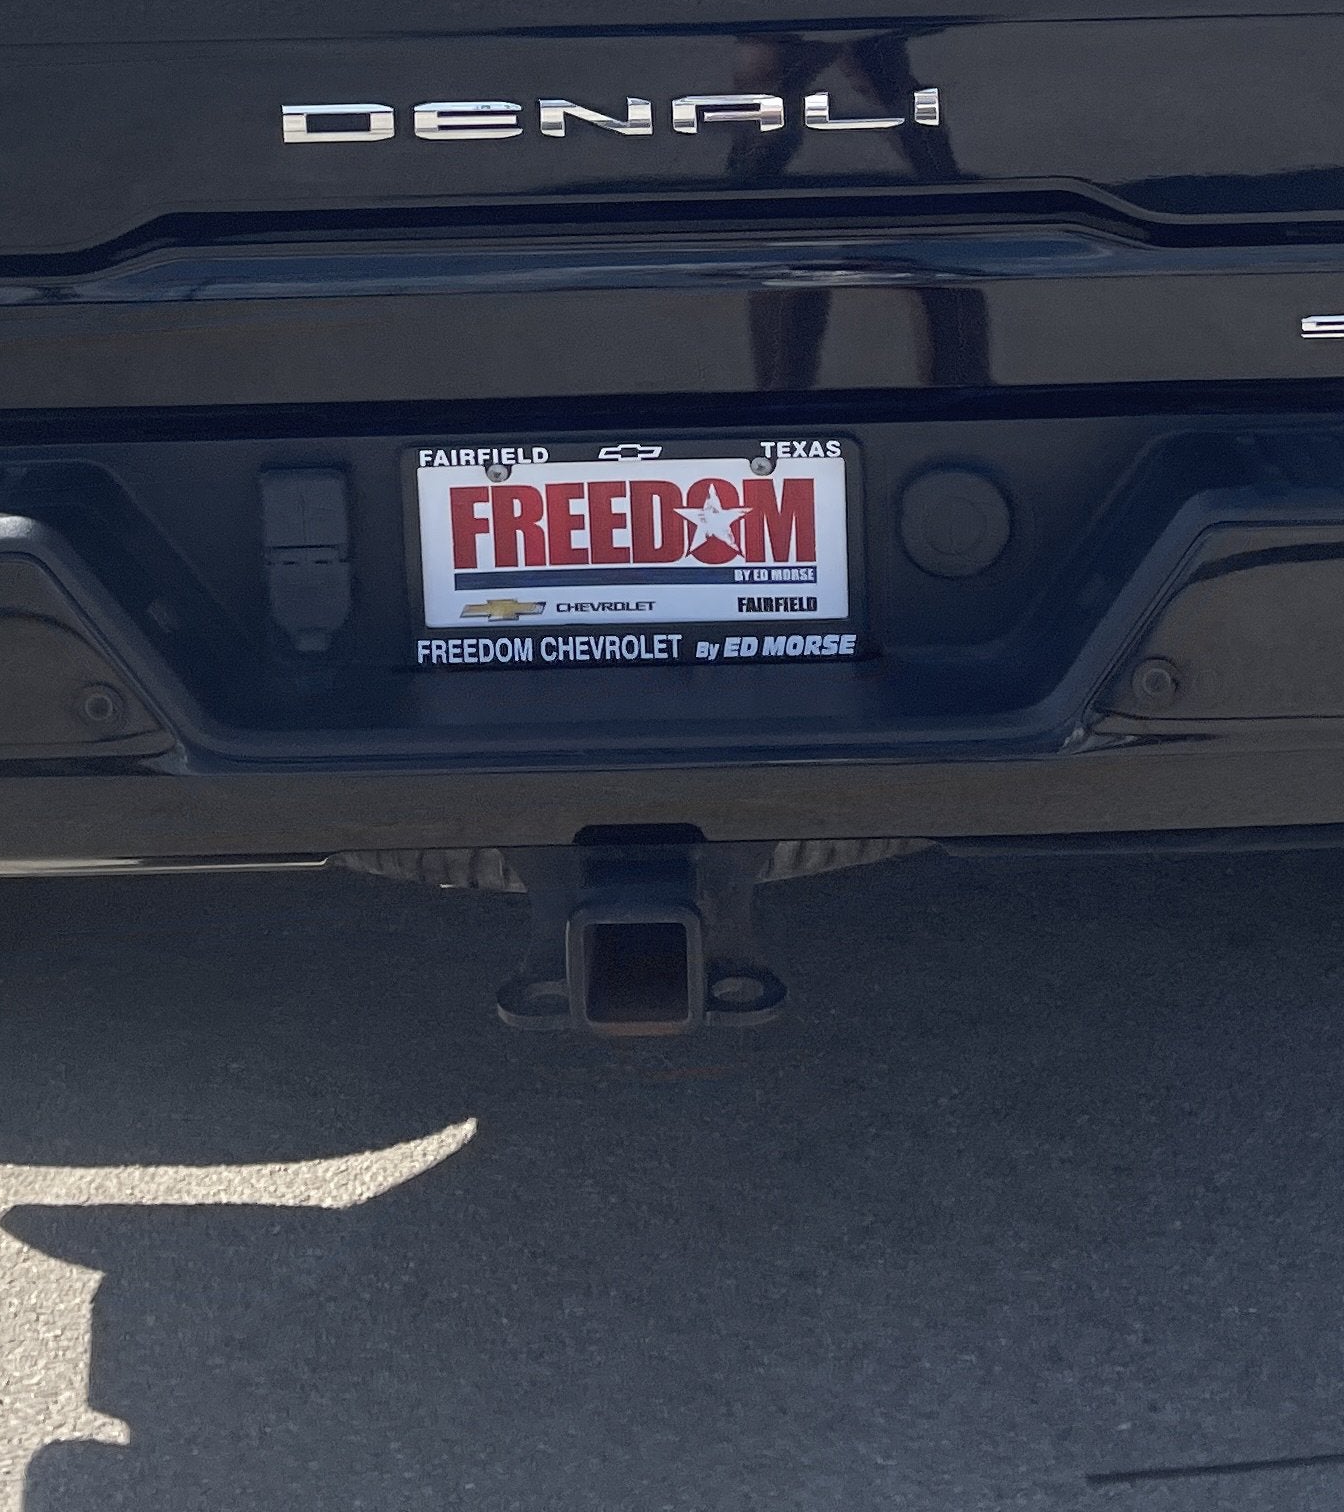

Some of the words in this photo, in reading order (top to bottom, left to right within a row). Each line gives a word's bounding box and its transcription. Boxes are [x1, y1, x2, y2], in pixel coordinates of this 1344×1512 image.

[280, 87, 940, 144] DENALI
[418, 447, 549, 468] FAIRFIELD
[760, 441, 843, 460] TEXAS
[449, 477, 817, 570] FREEDOM
[734, 569, 751, 582] BY
[753, 569, 769, 582] ED
[771, 568, 815, 582] MORSE
[556, 600, 656, 614] CHEVROLET
[737, 596, 818, 614] FAIRFIELD
[417, 638, 534, 664] FREEDOM
[541, 634, 682, 662] CHEVROLET
[695, 640, 720, 661] By
[723, 637, 759, 659] ED
[761, 634, 857, 657] MORSE
